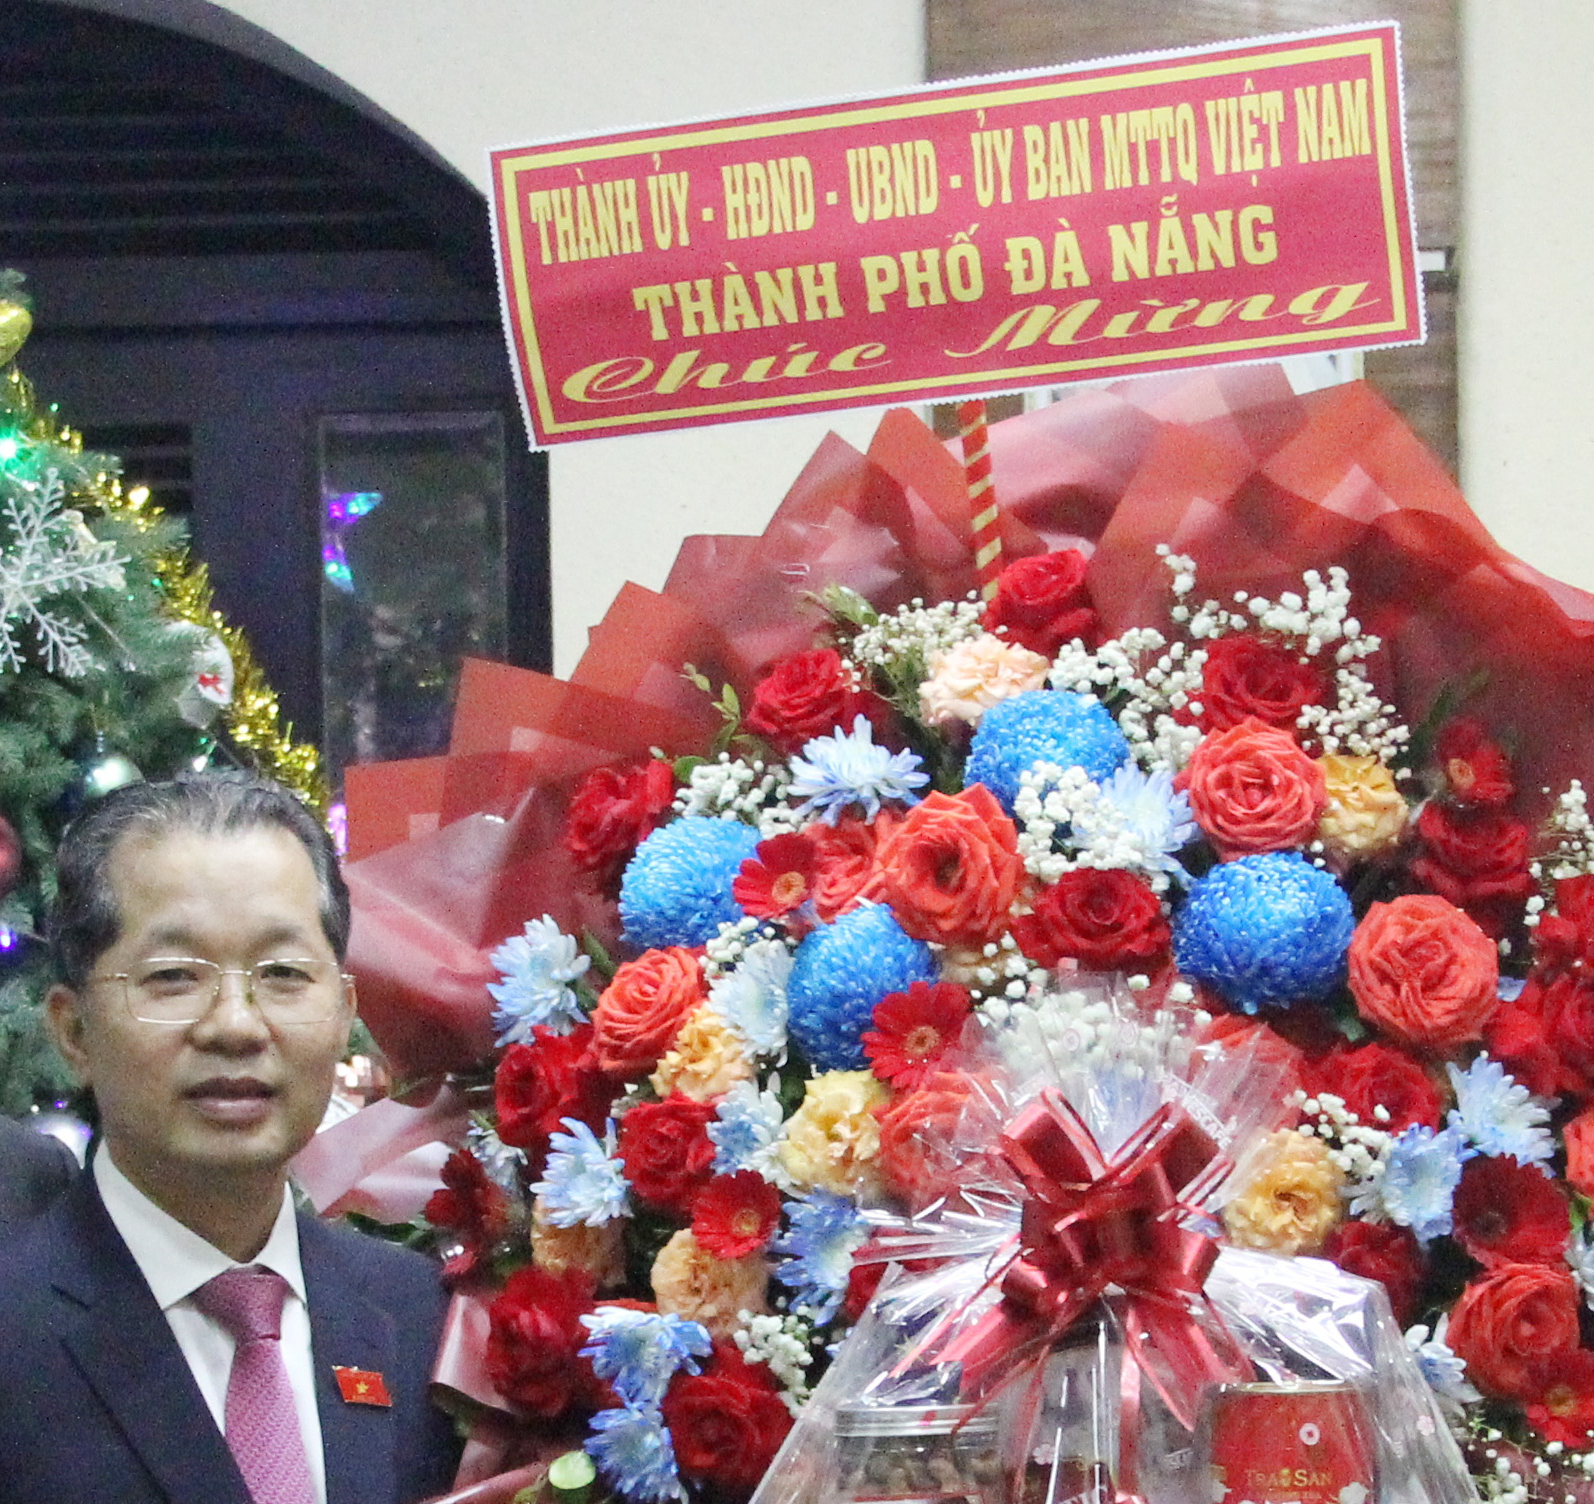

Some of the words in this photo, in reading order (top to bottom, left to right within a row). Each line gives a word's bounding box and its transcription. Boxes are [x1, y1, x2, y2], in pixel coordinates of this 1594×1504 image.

[528, 168, 643, 265] THÀNH
[647, 152, 690, 250] ỦY
[721, 155, 816, 240] HĐND
[846, 139, 939, 224] UBND
[970, 109, 1013, 208] ỦY
[1023, 117, 1092, 200] BAN
[1100, 102, 1198, 191] MTTQ
[1206, 78, 1285, 187] VIỆT
[1294, 78, 1371, 163] NAM
[632, 261, 845, 342] THÀNH
[860, 223, 985, 314] PHỐ
[1004, 217, 1091, 296] ĐÀ
[1108, 194, 1278, 283] NẴNG
[561, 343, 892, 403] Chúc
[944, 282, 1381, 358] Mừng
